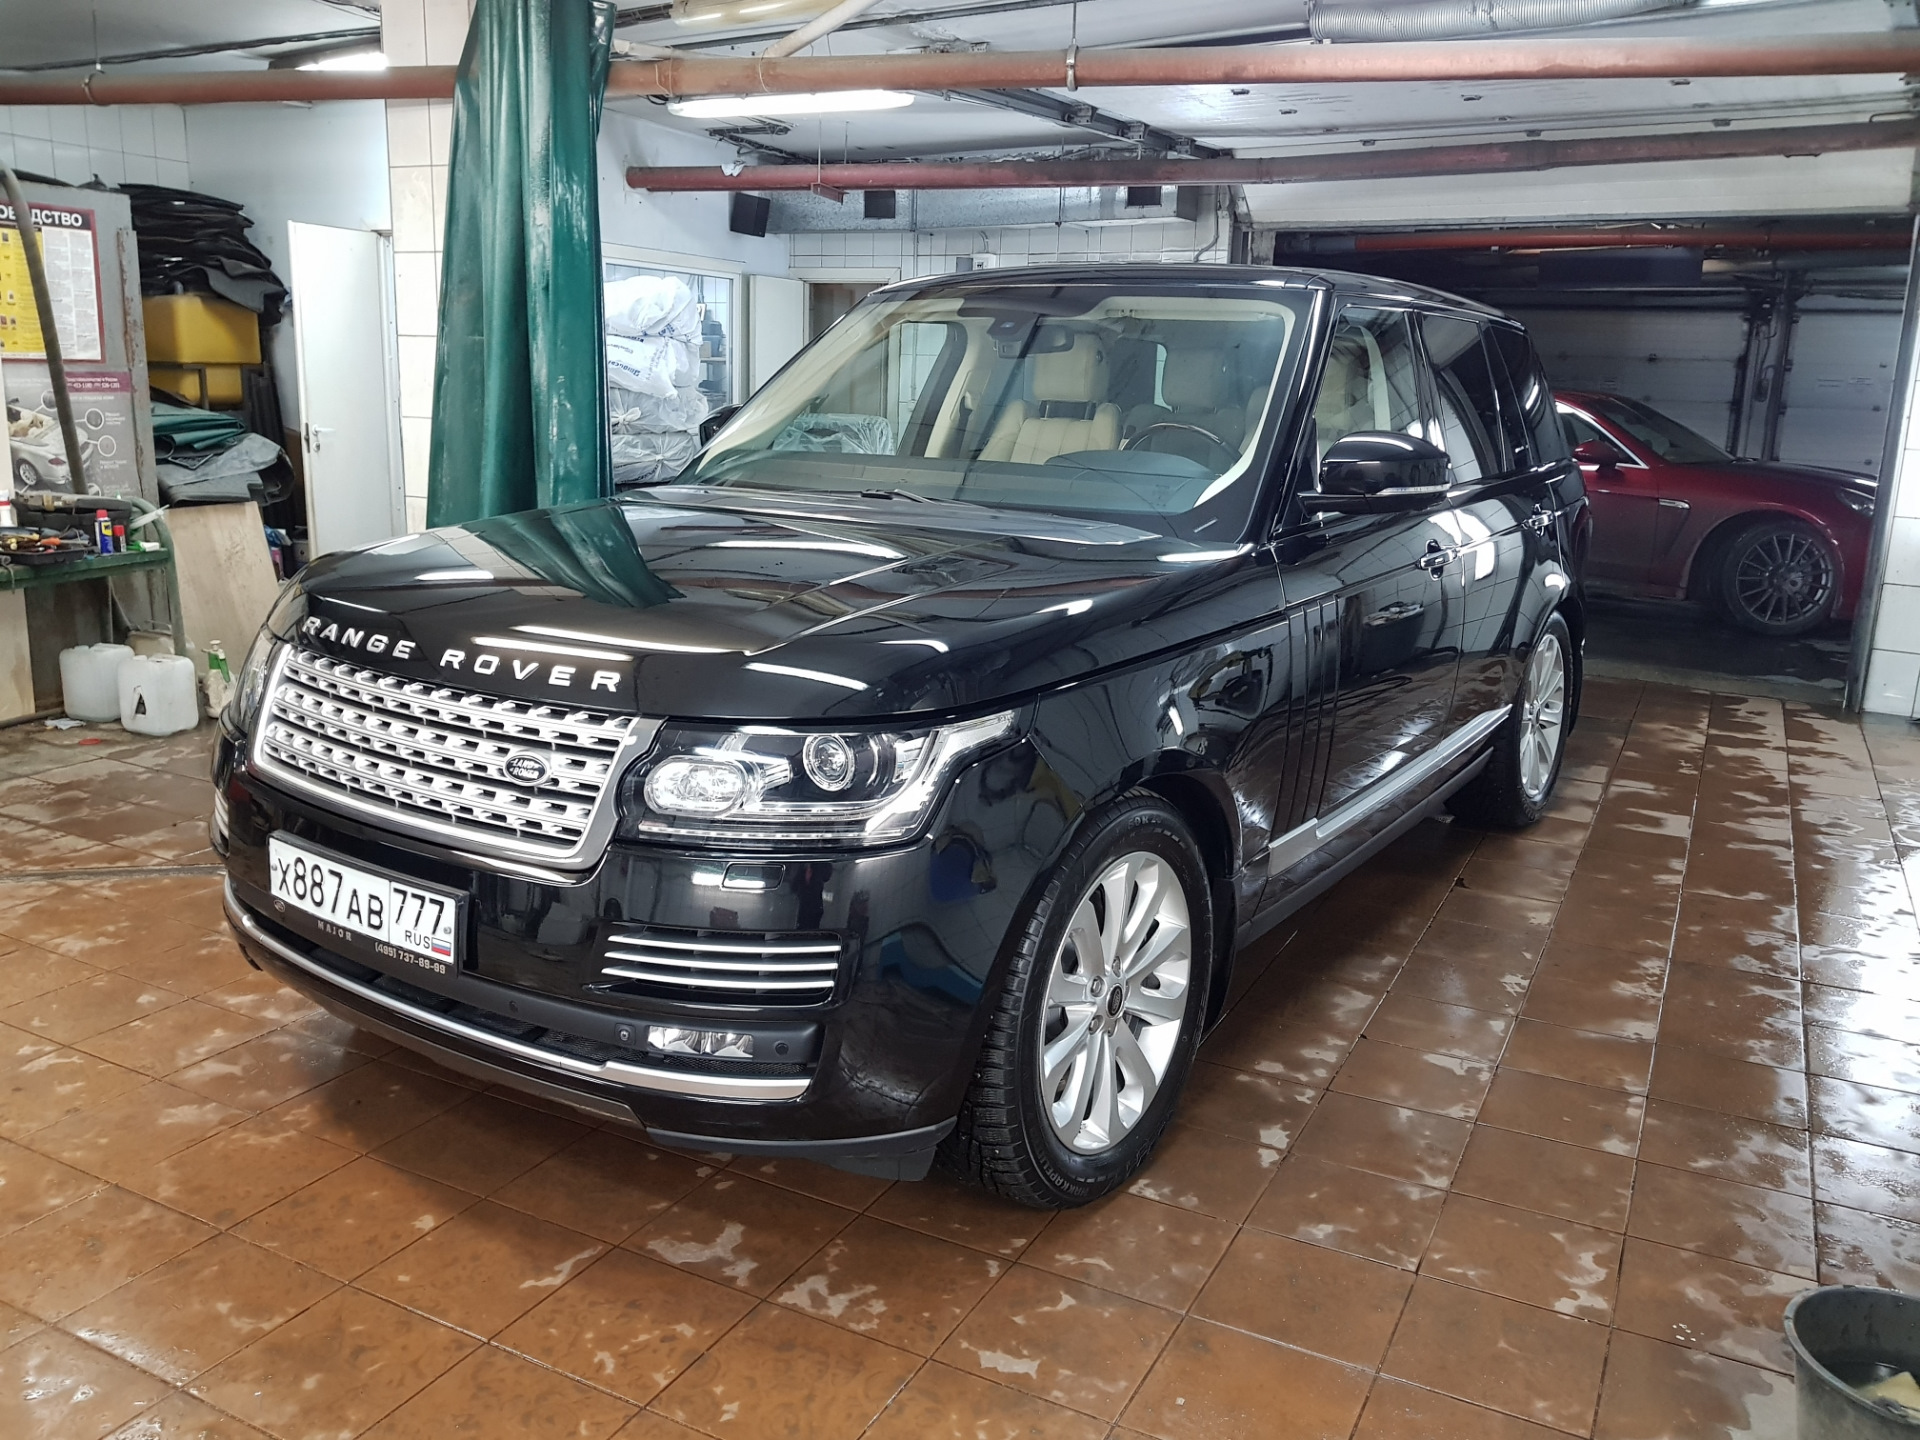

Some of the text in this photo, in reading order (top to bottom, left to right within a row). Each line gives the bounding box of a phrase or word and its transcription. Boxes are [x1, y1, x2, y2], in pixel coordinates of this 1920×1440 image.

[0, 204, 82, 227] ОВДСТВО
[301, 615, 623, 693] RANGE ROVER
[393, 887, 445, 935] 777
[317, 920, 352, 942] MAJOR
[405, 930, 431, 949] RUS
[374, 942, 446, 975] (495) 737-89-99
